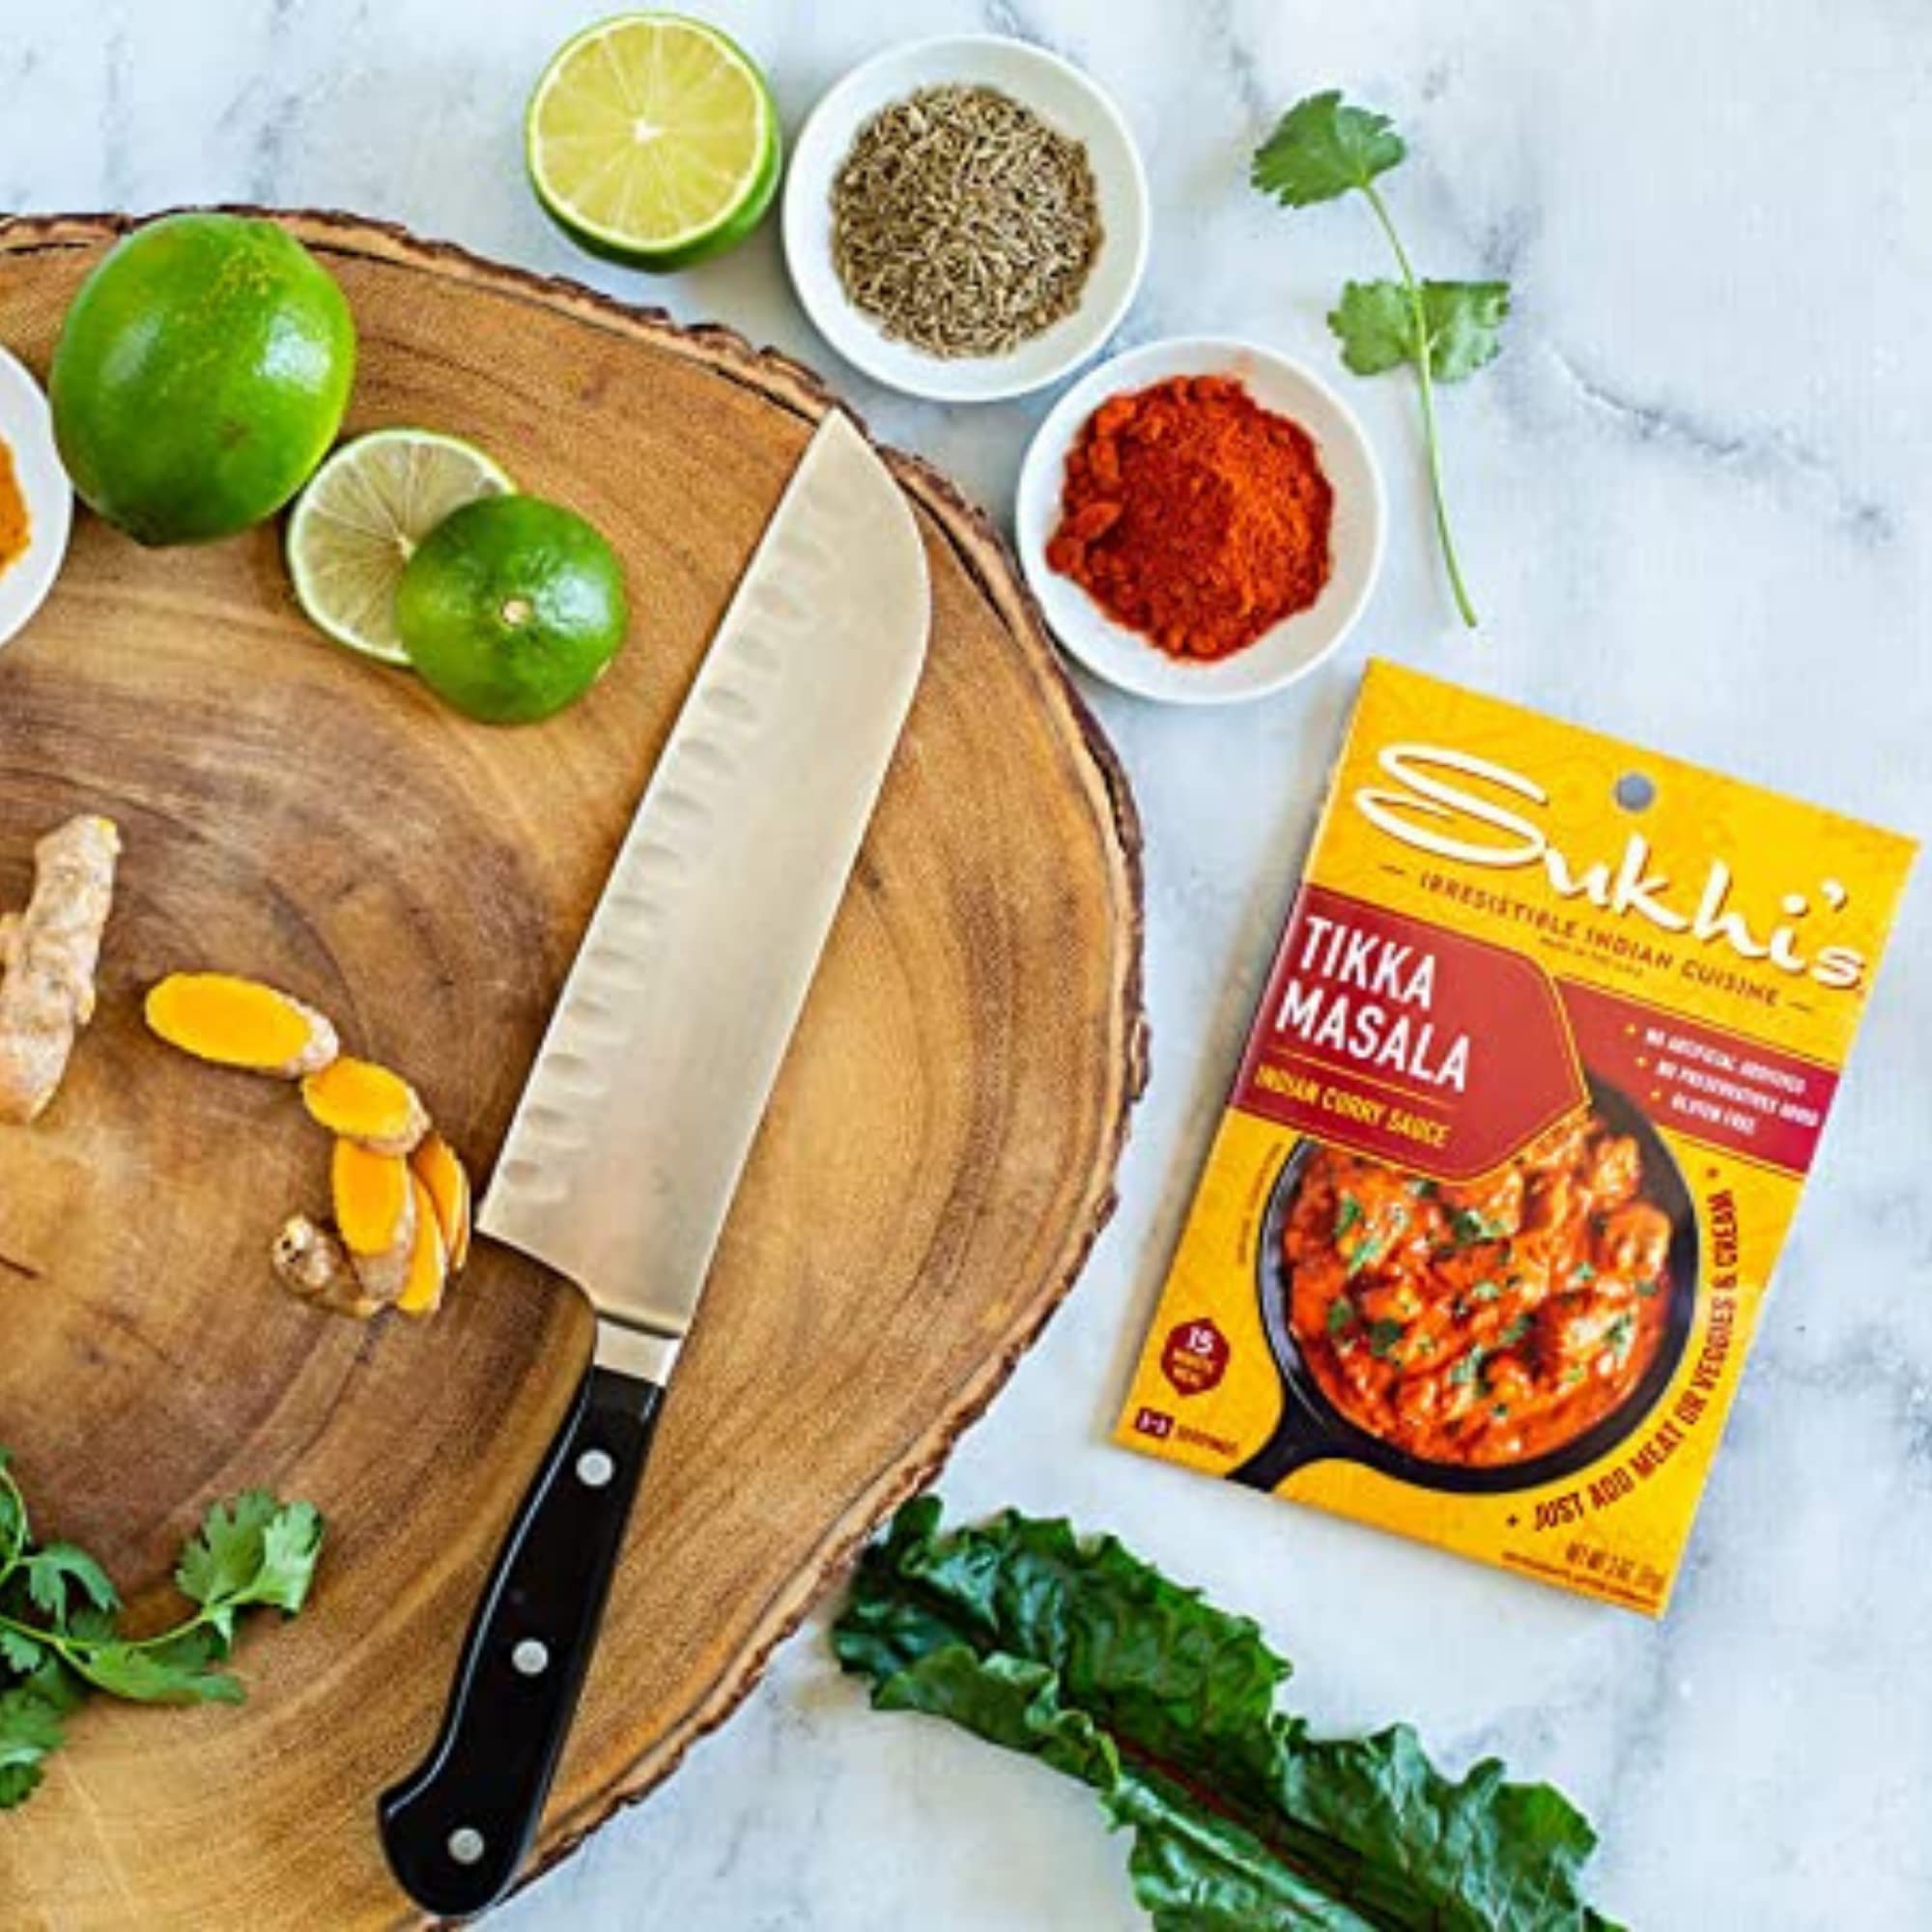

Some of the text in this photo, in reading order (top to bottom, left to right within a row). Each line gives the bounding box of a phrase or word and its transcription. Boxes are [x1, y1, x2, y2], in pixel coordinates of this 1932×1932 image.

[1356, 743, 1864, 990] Sukhi's
[1300, 915, 1435, 1010] TIKKA
[1421, 870, 1578, 938] IRRESISTIBLE
[1584, 928, 1674, 970] INDIAN
[1681, 959, 1779, 1006] CUISINE
[1275, 979, 1469, 1093] MASALA
[1255, 1064, 1451, 1148] INDIAN CURRY SAUCE
[1185, 1326, 1215, 1353] 15
[1534, 1189, 1738, 1531] JUST ADD MEAT OR VEGGIES & CREAM
